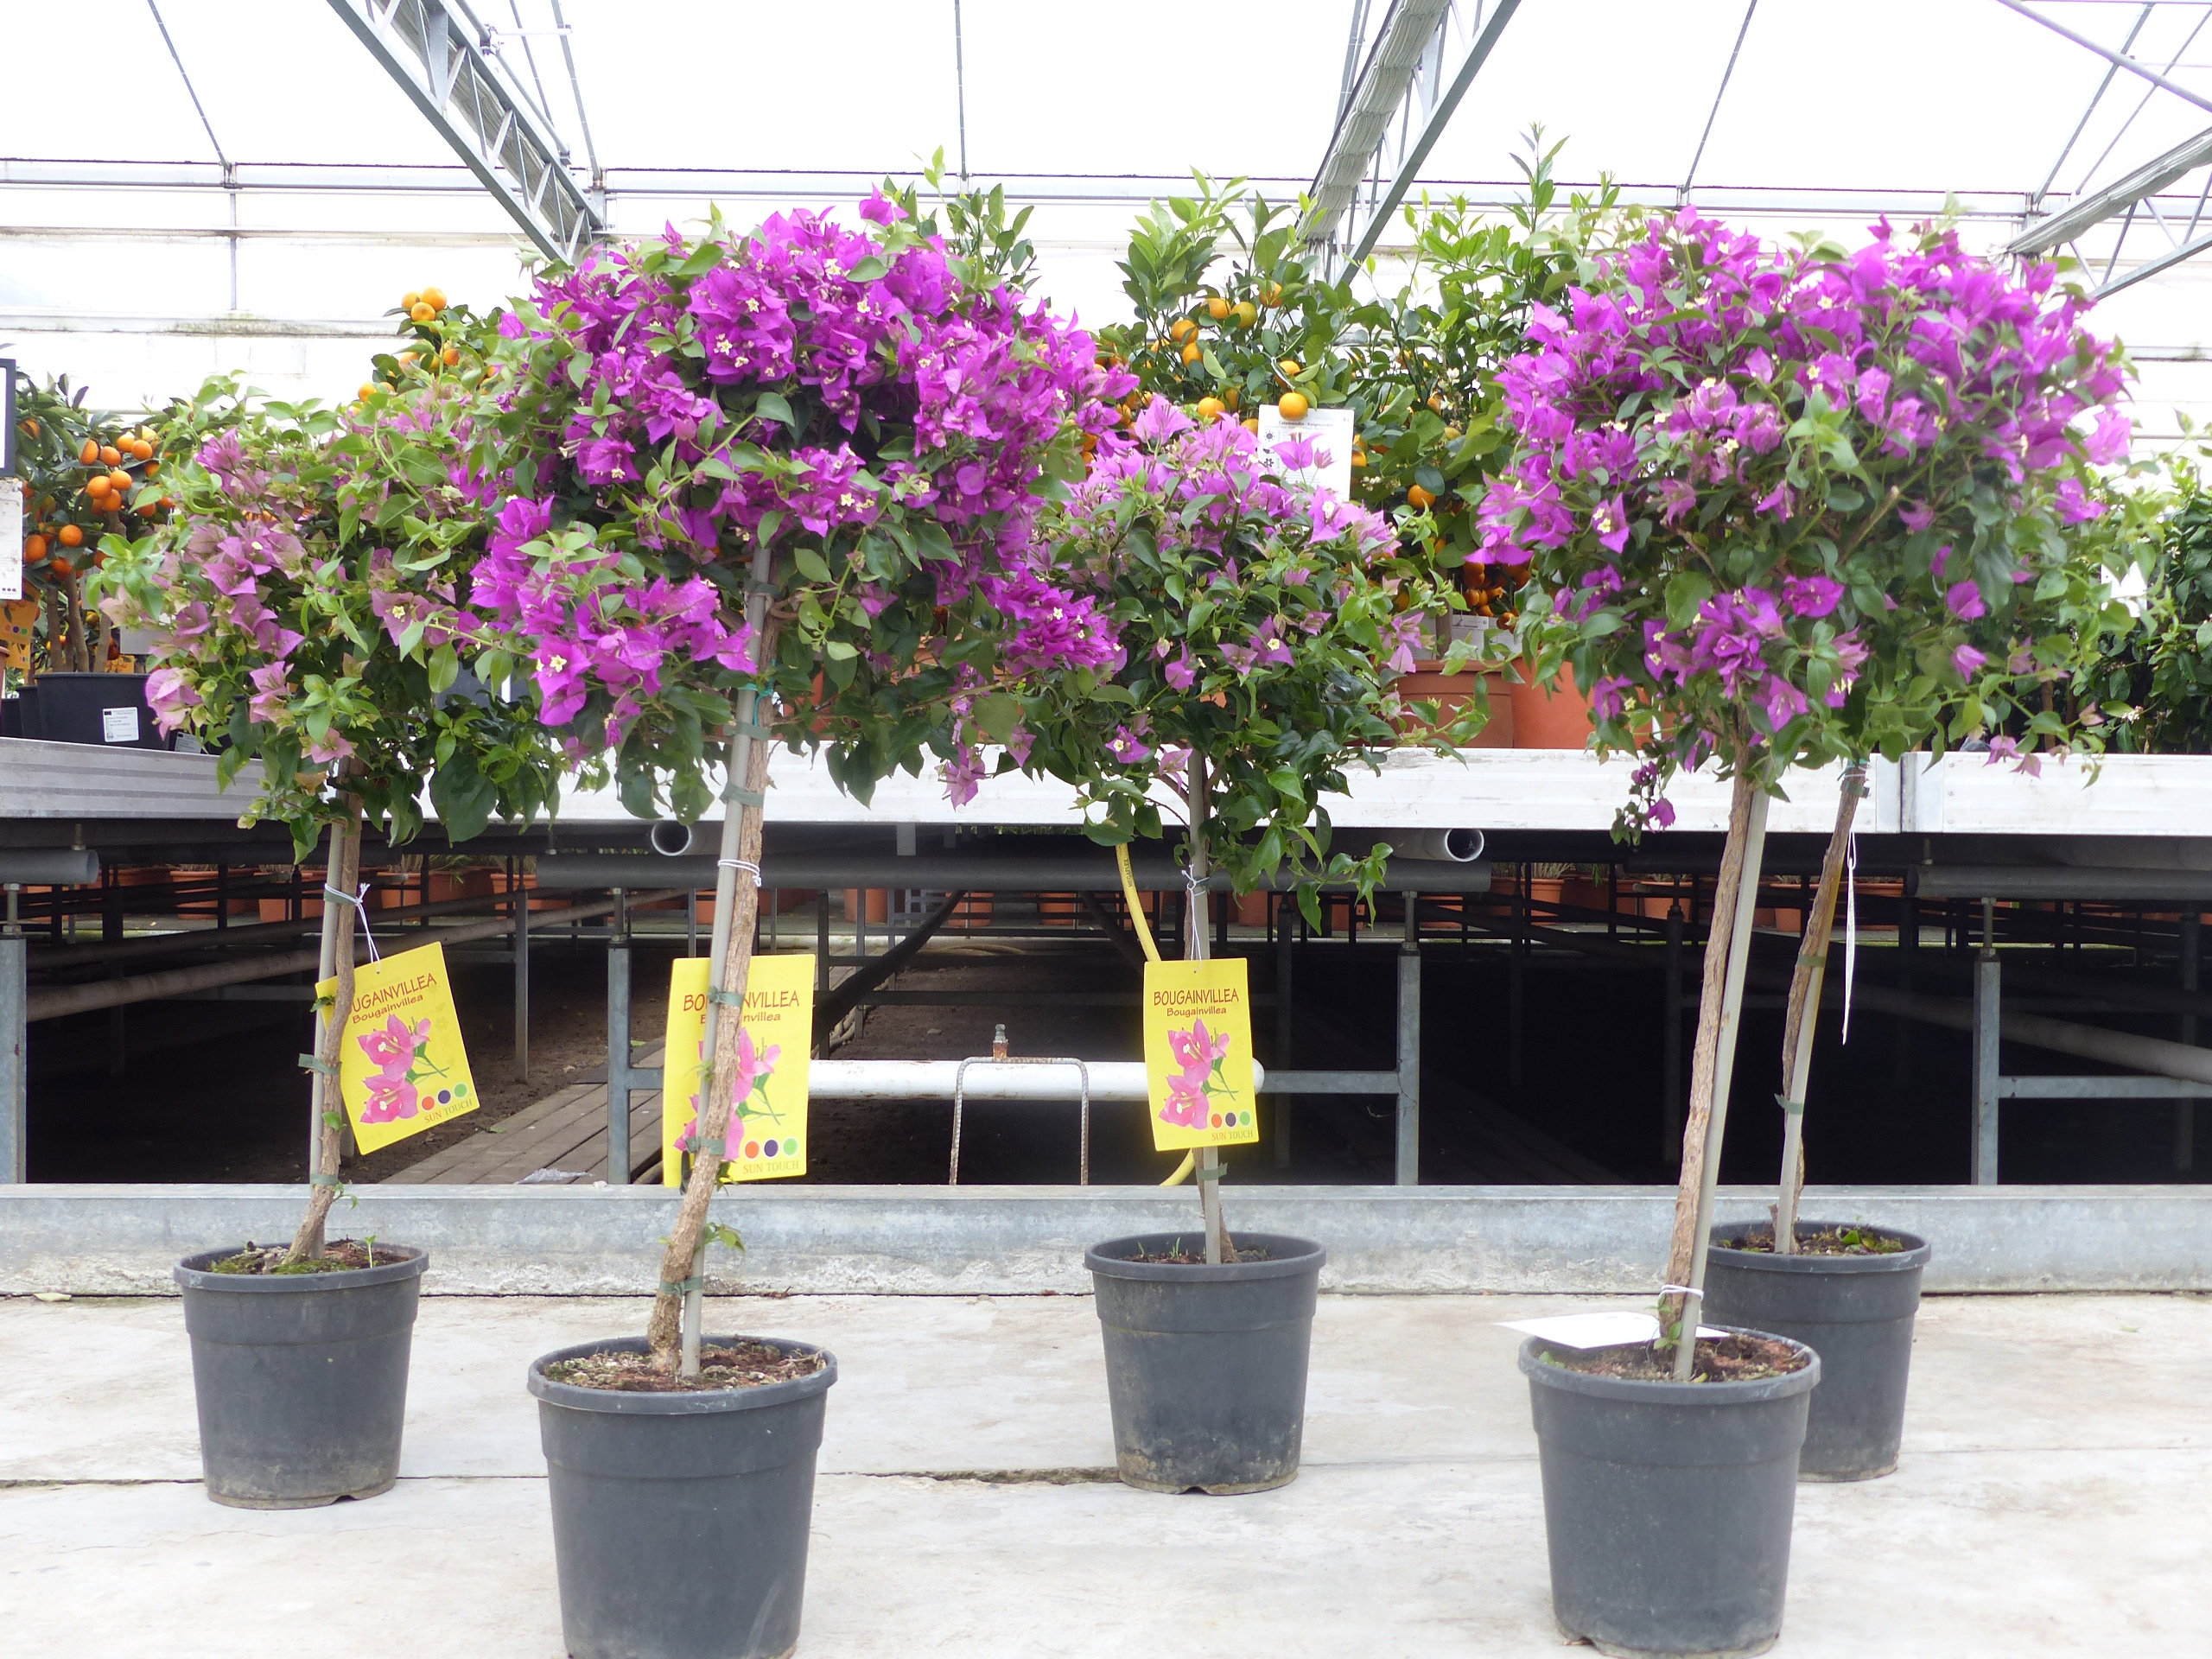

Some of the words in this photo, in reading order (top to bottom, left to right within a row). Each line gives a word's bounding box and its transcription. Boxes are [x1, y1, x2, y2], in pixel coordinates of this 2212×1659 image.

[1123, 859, 1134, 887] MEGAFLEX
[351, 972, 437, 1013] UGAINVILLEA
[683, 990, 800, 1012] BONVILLEA
[1154, 988, 1239, 1006] BOUGAINVILLEA
[353, 994, 423, 1024] Bougainvillea
[700, 1012, 781, 1025] Bnvillea
[1166, 1006, 1227, 1018] Bougainvillea
[423, 1110, 442, 1124] SUN
[443, 1098, 473, 1116] TOUCH
[1211, 1132, 1227, 1141] SUN
[1229, 1129, 1254, 1140] TOUCH
[743, 1163, 763, 1174] SUN
[766, 1160, 799, 1173] TOUCH
